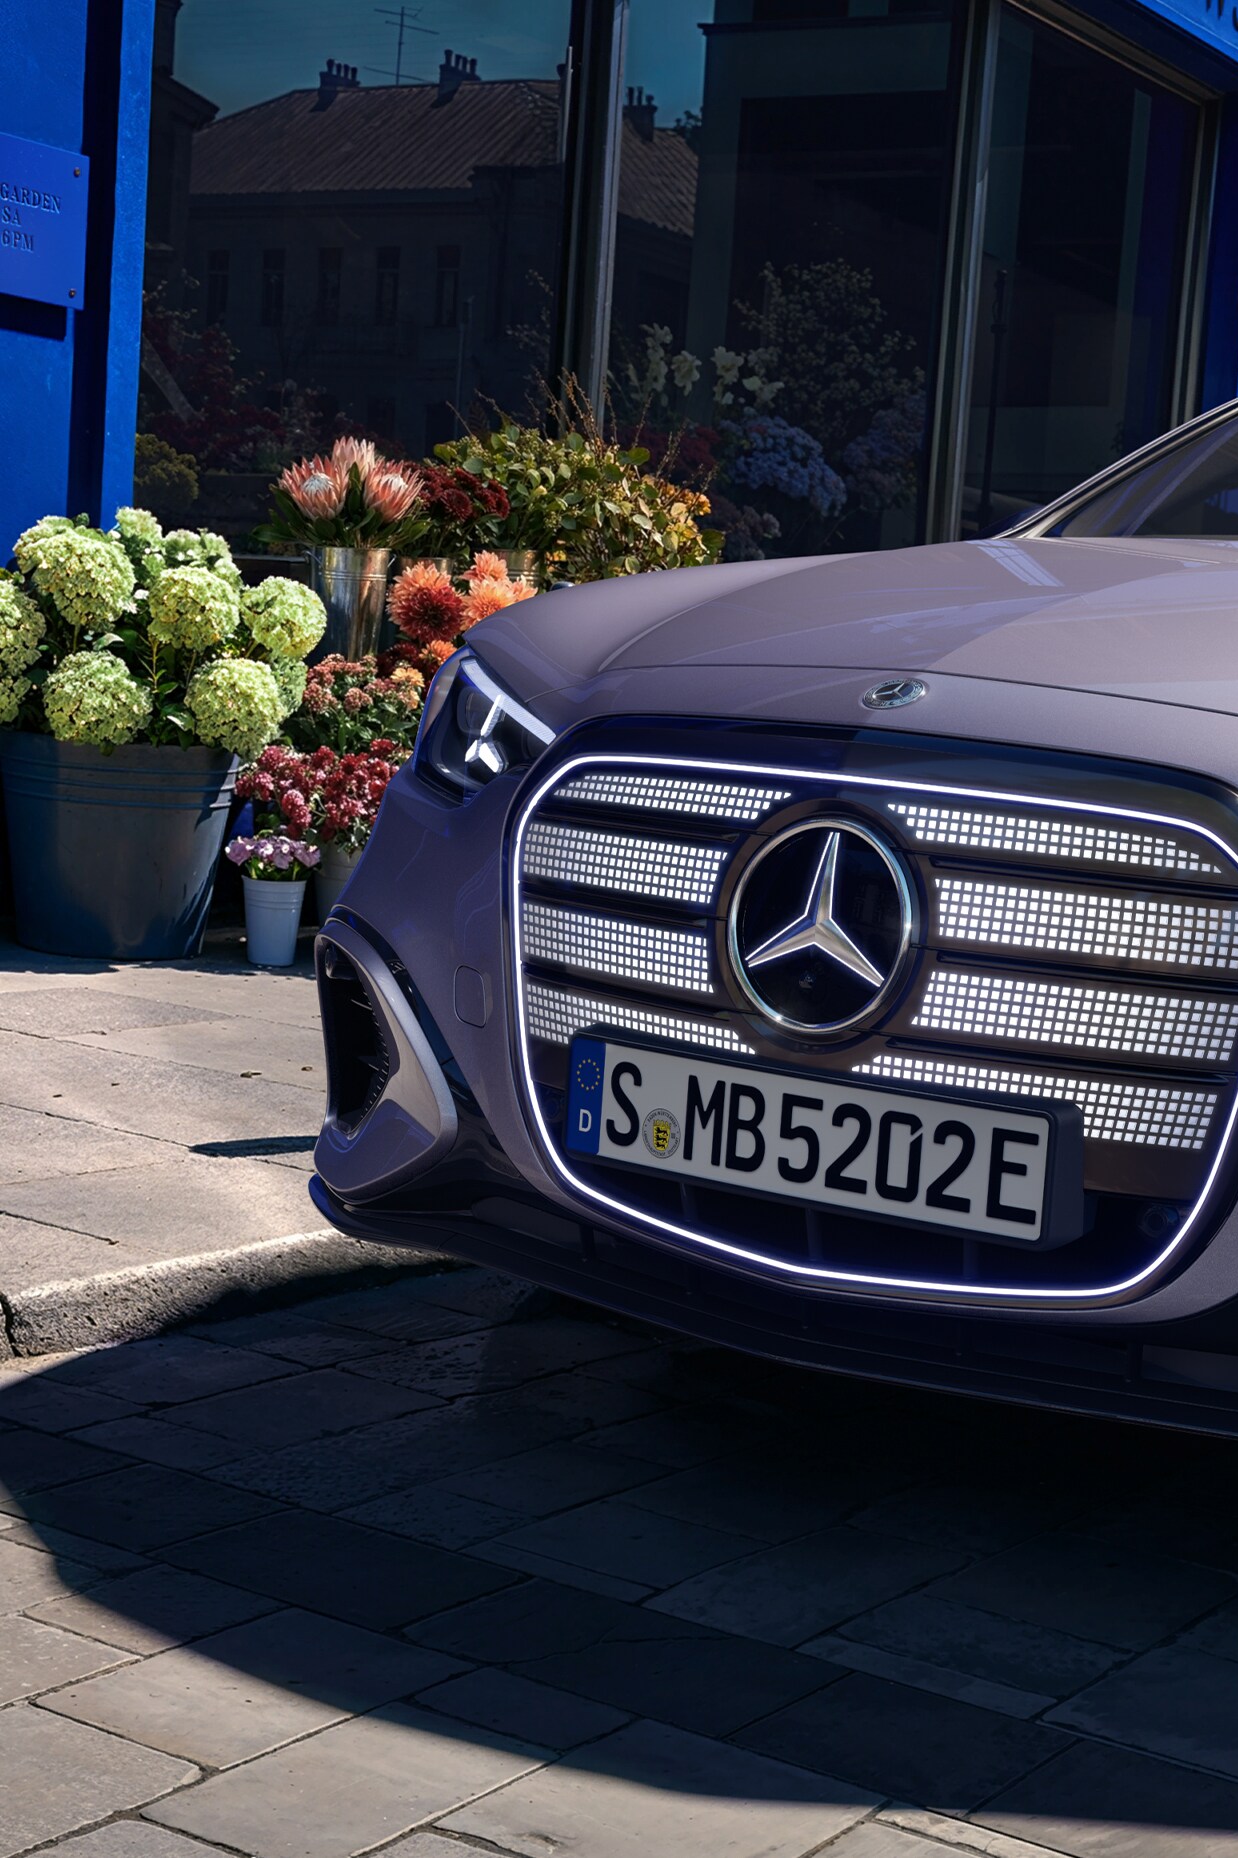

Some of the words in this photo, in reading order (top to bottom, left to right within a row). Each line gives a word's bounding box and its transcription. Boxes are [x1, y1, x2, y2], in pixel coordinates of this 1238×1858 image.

[0, 183, 61, 214] GARDEN
[2, 205, 21, 227] SA
[2, 229, 34, 253] 6PM
[578, 1109, 593, 1133] D
